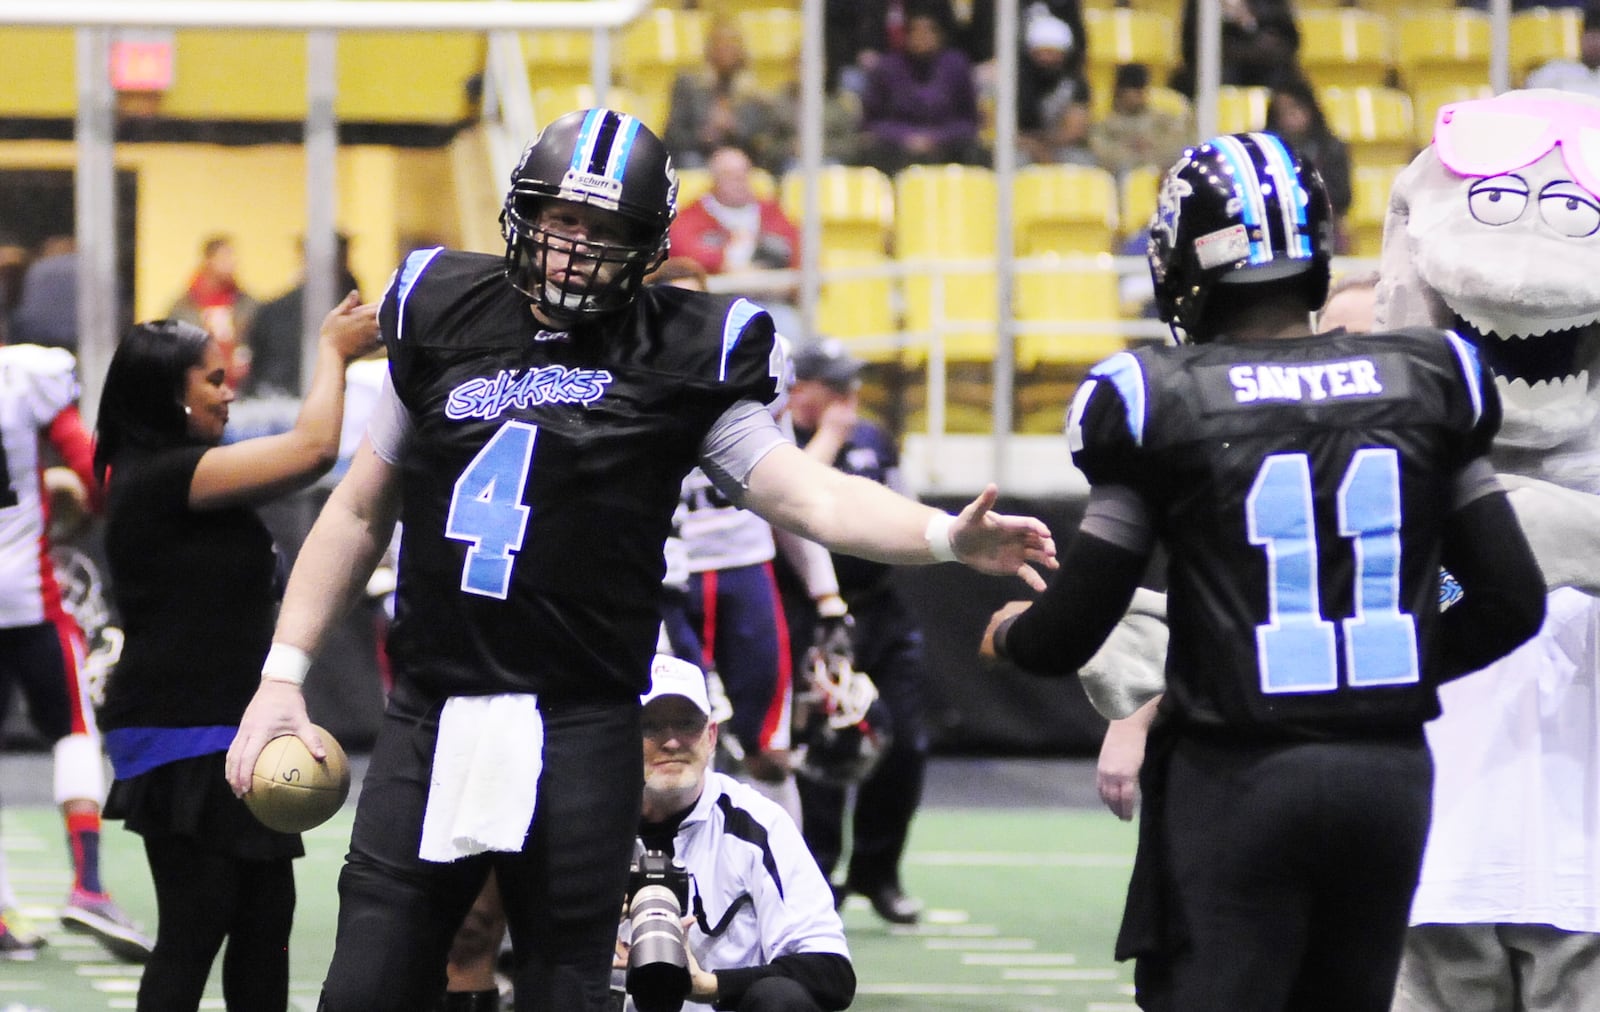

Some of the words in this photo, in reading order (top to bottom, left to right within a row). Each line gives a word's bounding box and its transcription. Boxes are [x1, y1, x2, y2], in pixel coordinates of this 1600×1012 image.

[445, 364, 613, 420] SHARKS
[1229, 359, 1383, 403] SAWYER
[445, 420, 538, 600] 4
[1245, 448, 1420, 694] 11
